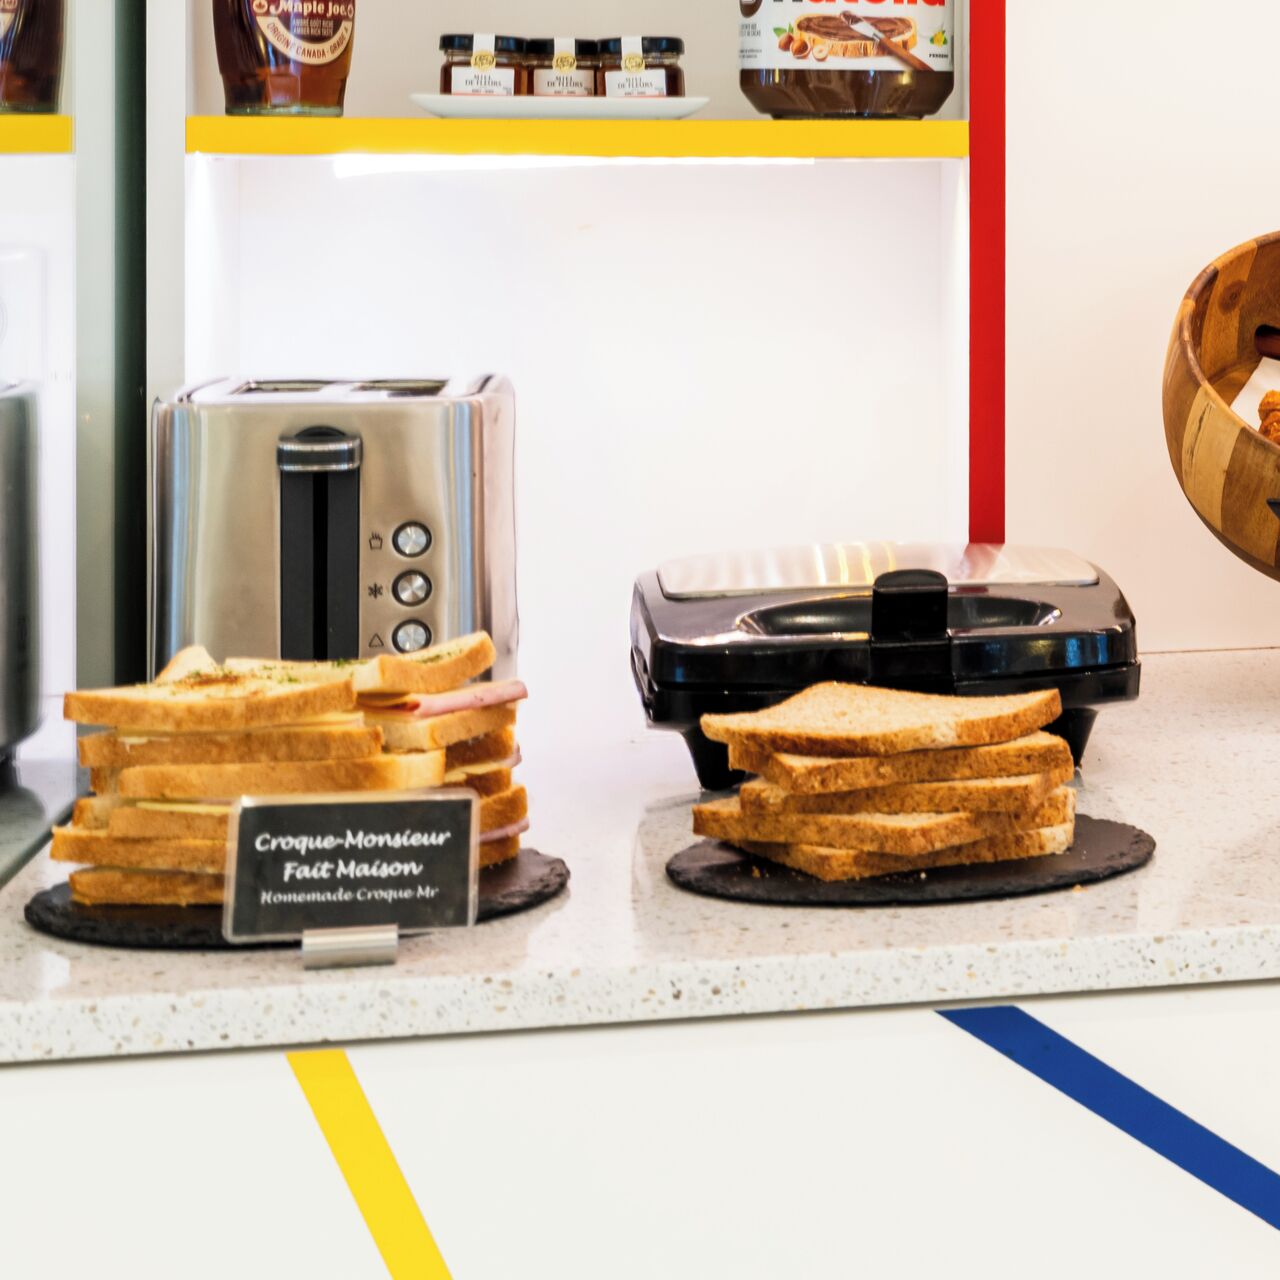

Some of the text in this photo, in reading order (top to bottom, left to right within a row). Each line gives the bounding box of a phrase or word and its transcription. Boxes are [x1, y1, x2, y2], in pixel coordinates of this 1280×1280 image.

[269, 0, 325, 17] Maple
[296, 45, 327, 59] CANADA
[255, 829, 452, 856] Croque-Monsieur
[283, 858, 424, 882] Fait Maison
[260, 884, 440, 905] Homemade Croque Mr
